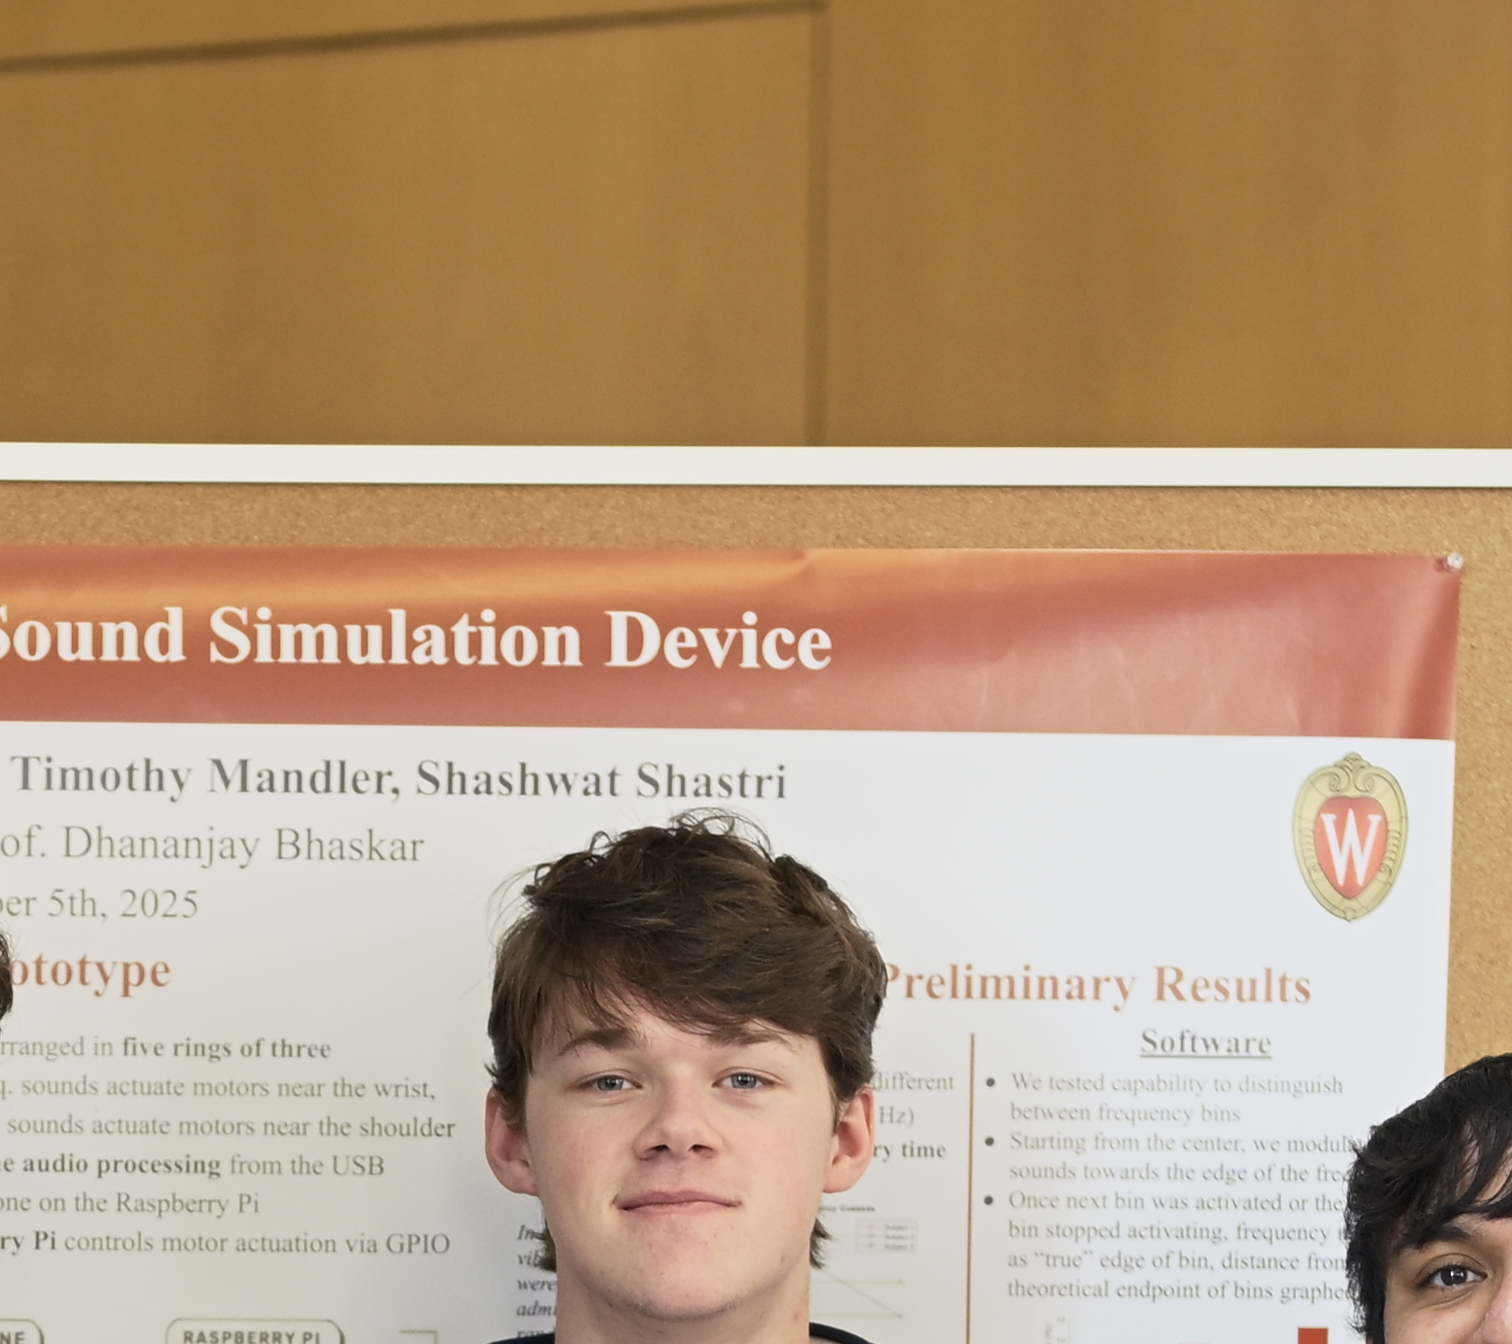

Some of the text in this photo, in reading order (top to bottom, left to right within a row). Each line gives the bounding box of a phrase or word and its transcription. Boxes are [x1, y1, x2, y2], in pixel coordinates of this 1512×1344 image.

[209, 605, 584, 667] Simulation
[604, 610, 833, 671] Device
[9, 755, 193, 804] Timothy
[208, 757, 401, 801] Mandler,
[416, 759, 621, 798] Shashwat
[636, 761, 786, 800] Shastri
[63, 824, 260, 870] Dhananjay
[275, 827, 426, 862] Bhaskar
[1320, 808, 1383, 888] W
[47, 887, 108, 921] 5th,
[119, 888, 199, 920] 2025
[885, 962, 1312, 1013] Preliminary Results
[122, 1036, 332, 1063] five rings three
[1138, 1028, 1273, 1060] Software
[21, 1074, 436, 1102] sounds actuate motors near wrist,
[873, 1072, 954, 1091] different
[1047, 1072, 1344, 1099] tested distinguish
[6, 1112, 457, 1139] sounds actuate motors near shoulder
[1009, 1100, 1192, 1127] between frequency
[901, 1140, 947, 1159] time
[1009, 1130, 1246, 1156] Starting center,
[22, 1152, 385, 1180] audio processing from USB
[1008, 1161, 1160, 1181] sounds towards
[116, 1191, 230, 1220] Raspberry
[1065, 1192, 1283, 1212] next activated
[63, 1230, 451, 1255] controls motor actuation GPIO
[1044, 1220, 1328, 1247] stopped activating, frequency
[1220, 1250, 1300, 1271] distance
[1005, 1276, 1201, 1304] theoretical endpoint
